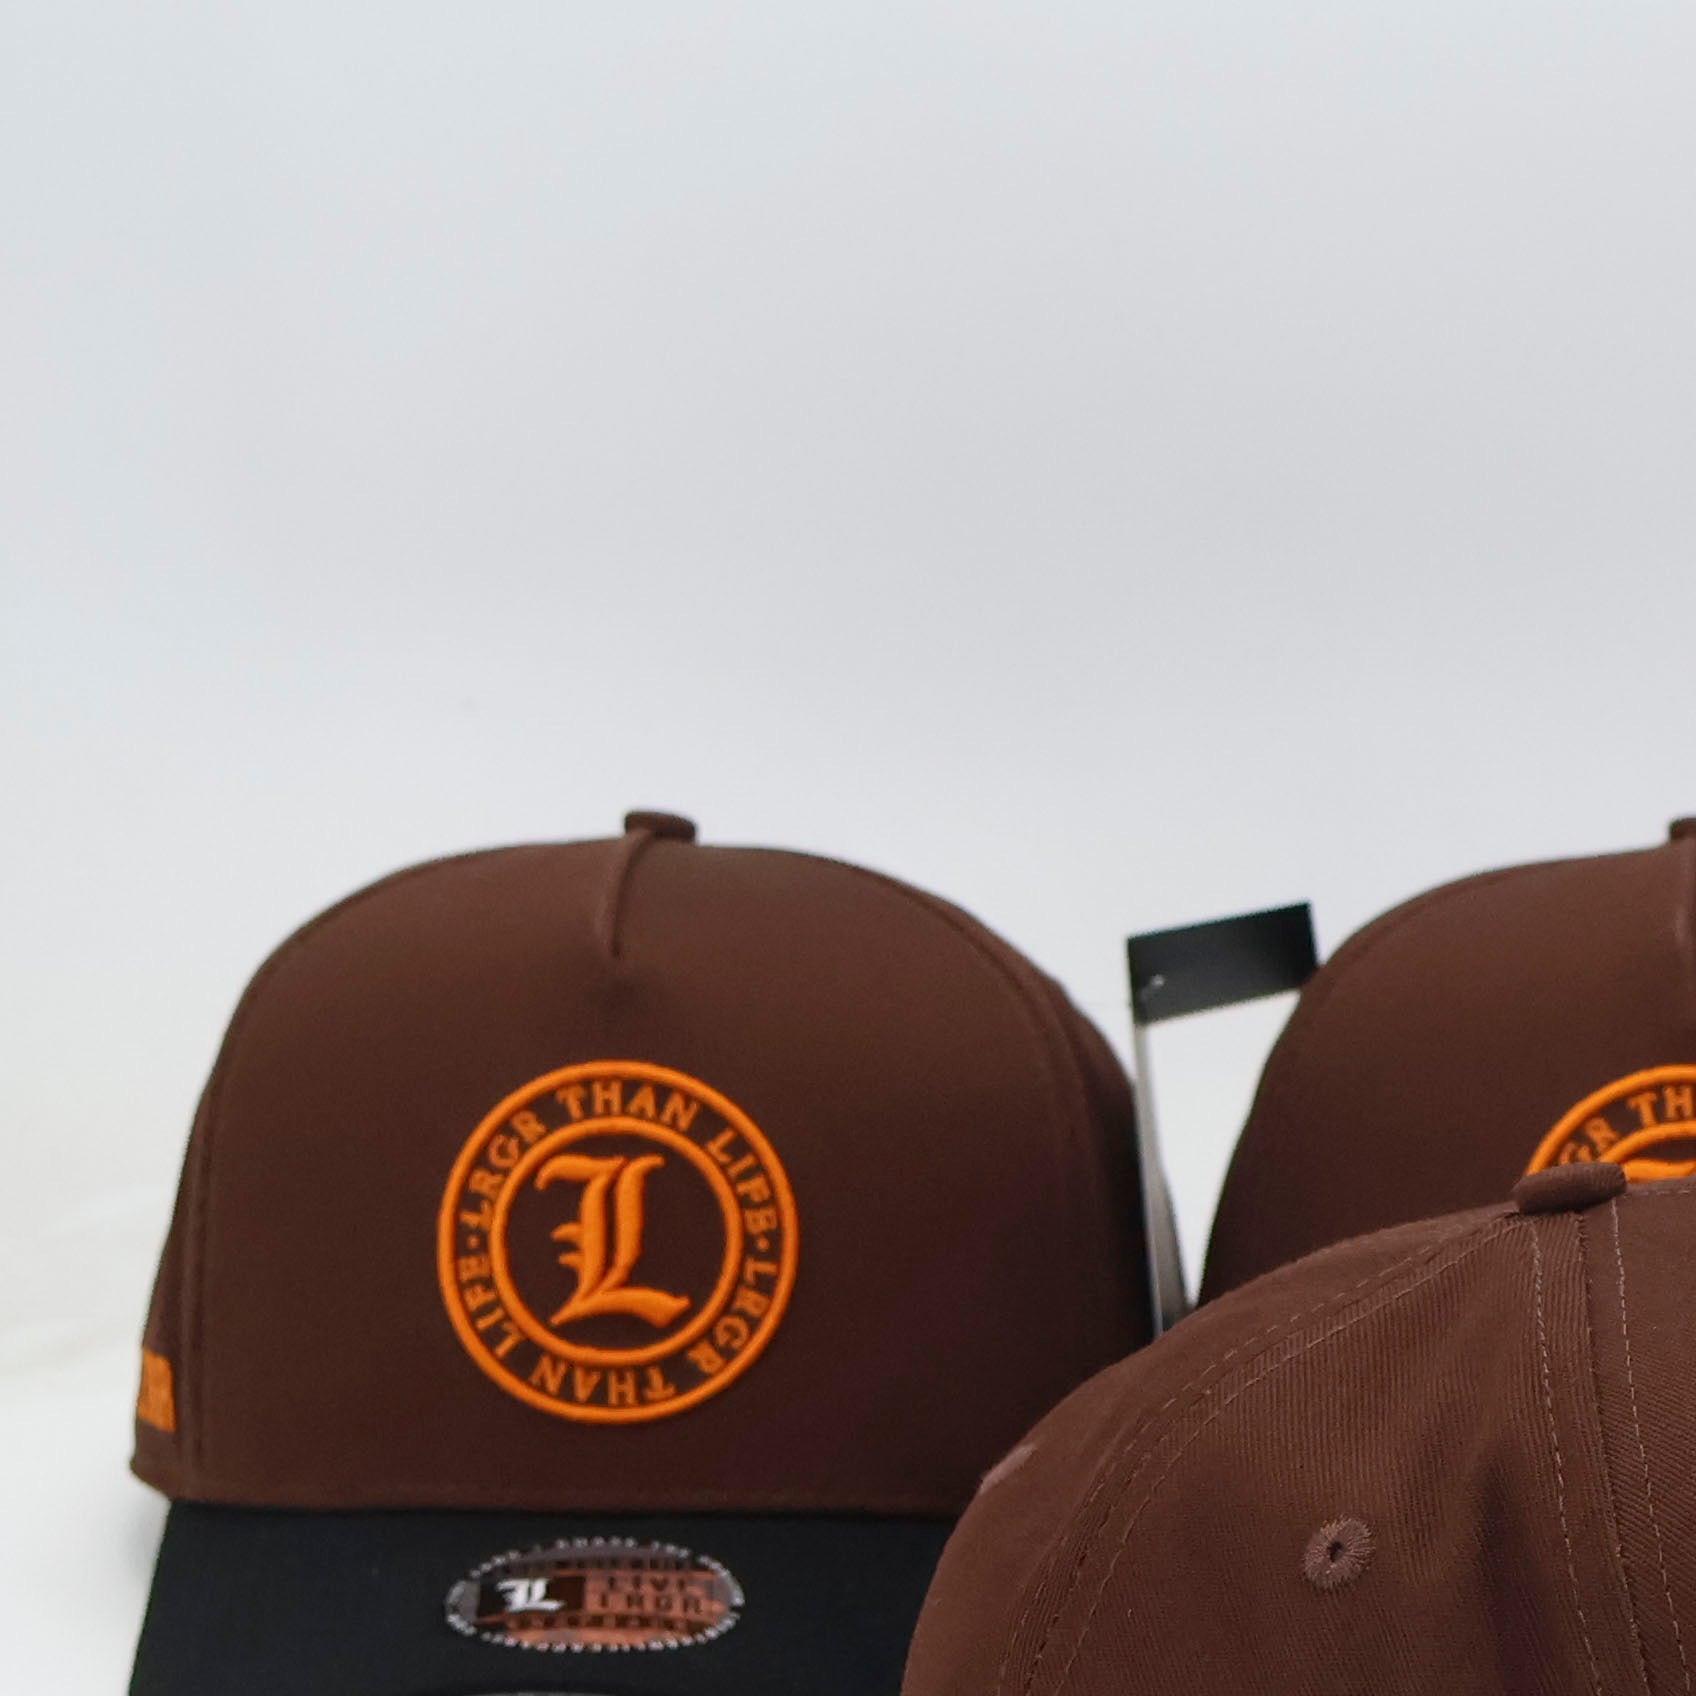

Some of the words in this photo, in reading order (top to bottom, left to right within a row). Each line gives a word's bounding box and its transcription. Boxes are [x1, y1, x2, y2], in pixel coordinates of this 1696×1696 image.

[459, 1110, 548, 1231] LRGR
[556, 1080, 698, 1132] THAN
[533, 1153, 692, 1327] L
[529, 1352, 678, 1405] THAN
[687, 1259, 778, 1375] LRGR
